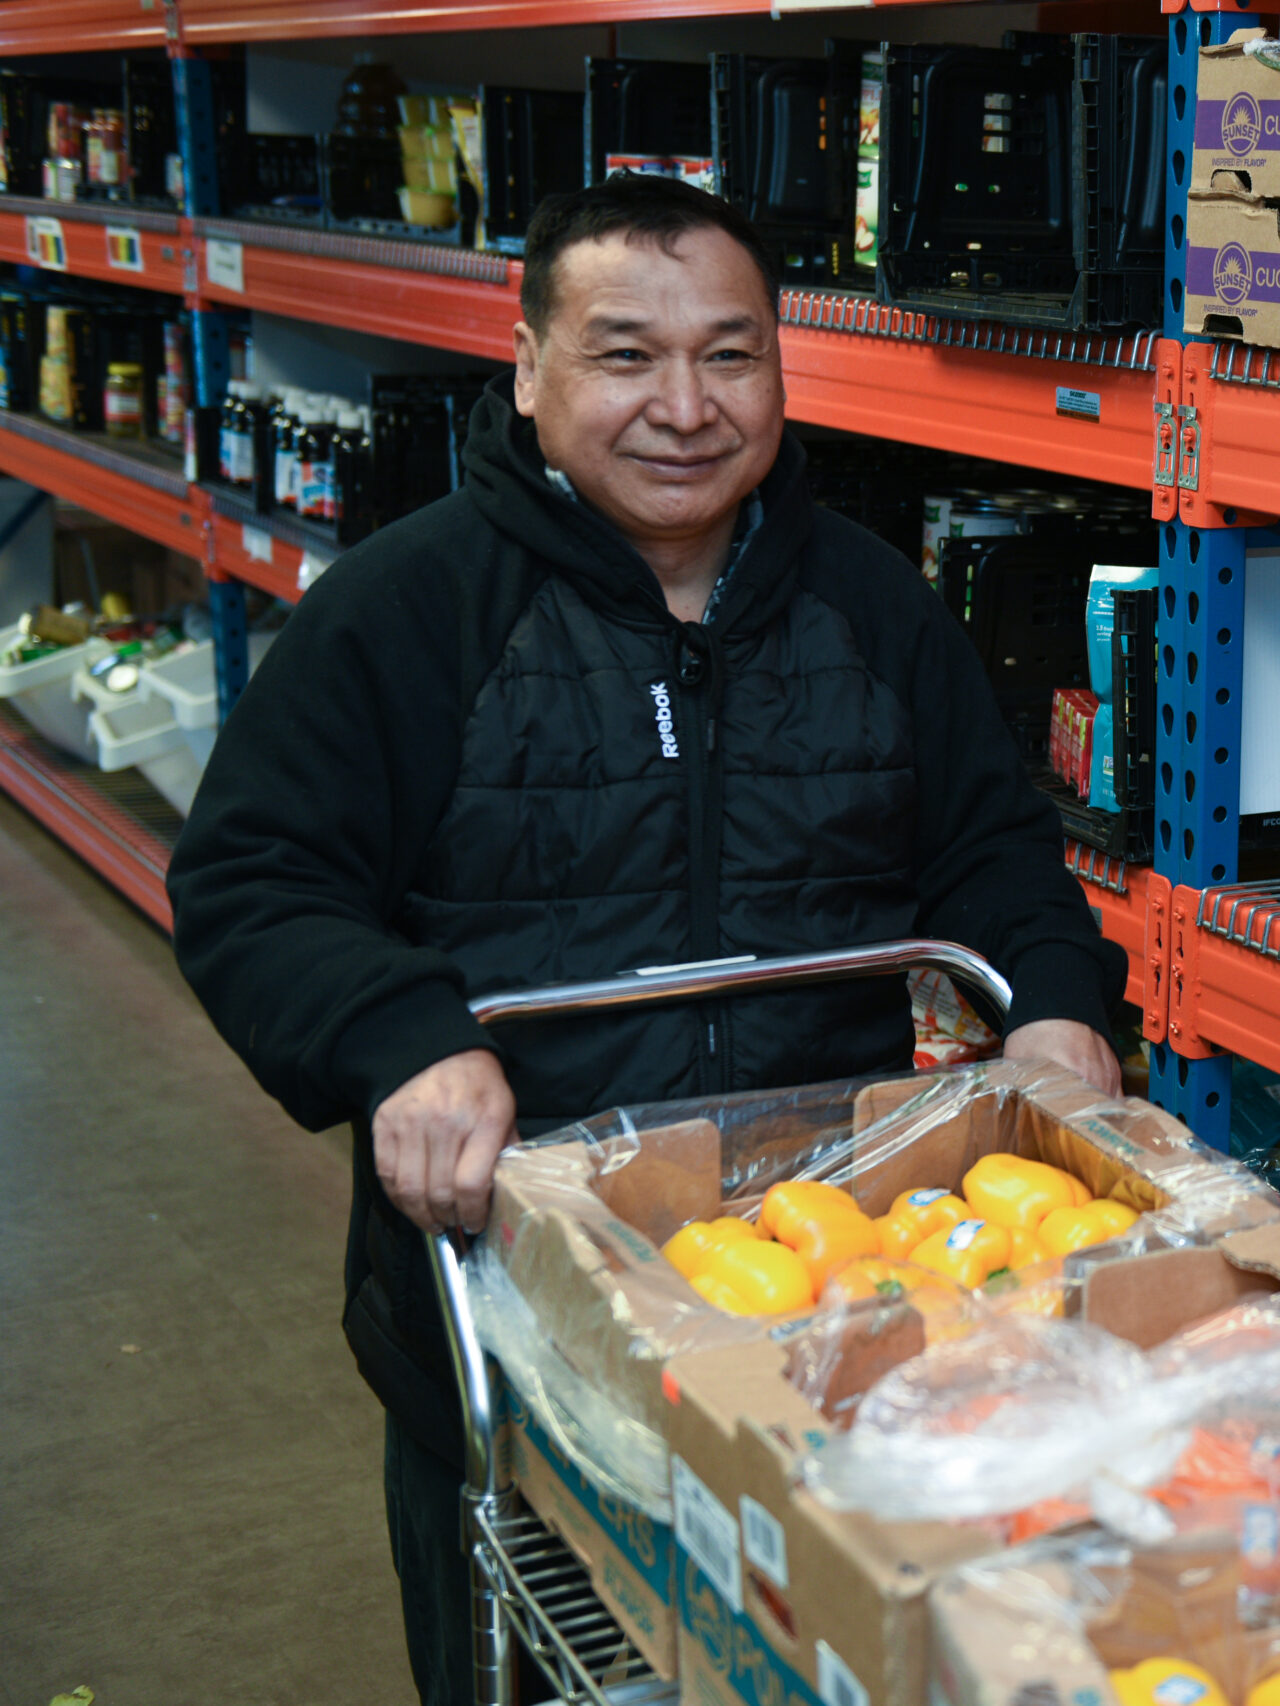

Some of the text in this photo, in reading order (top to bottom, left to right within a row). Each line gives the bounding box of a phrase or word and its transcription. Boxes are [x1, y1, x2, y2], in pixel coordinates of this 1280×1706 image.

[1222, 123, 1261, 143] SUNSET
[1212, 158, 1235, 167] INSPIRED
[1214, 273, 1251, 292] SUNSET
[650, 682, 679, 758] Reebok
